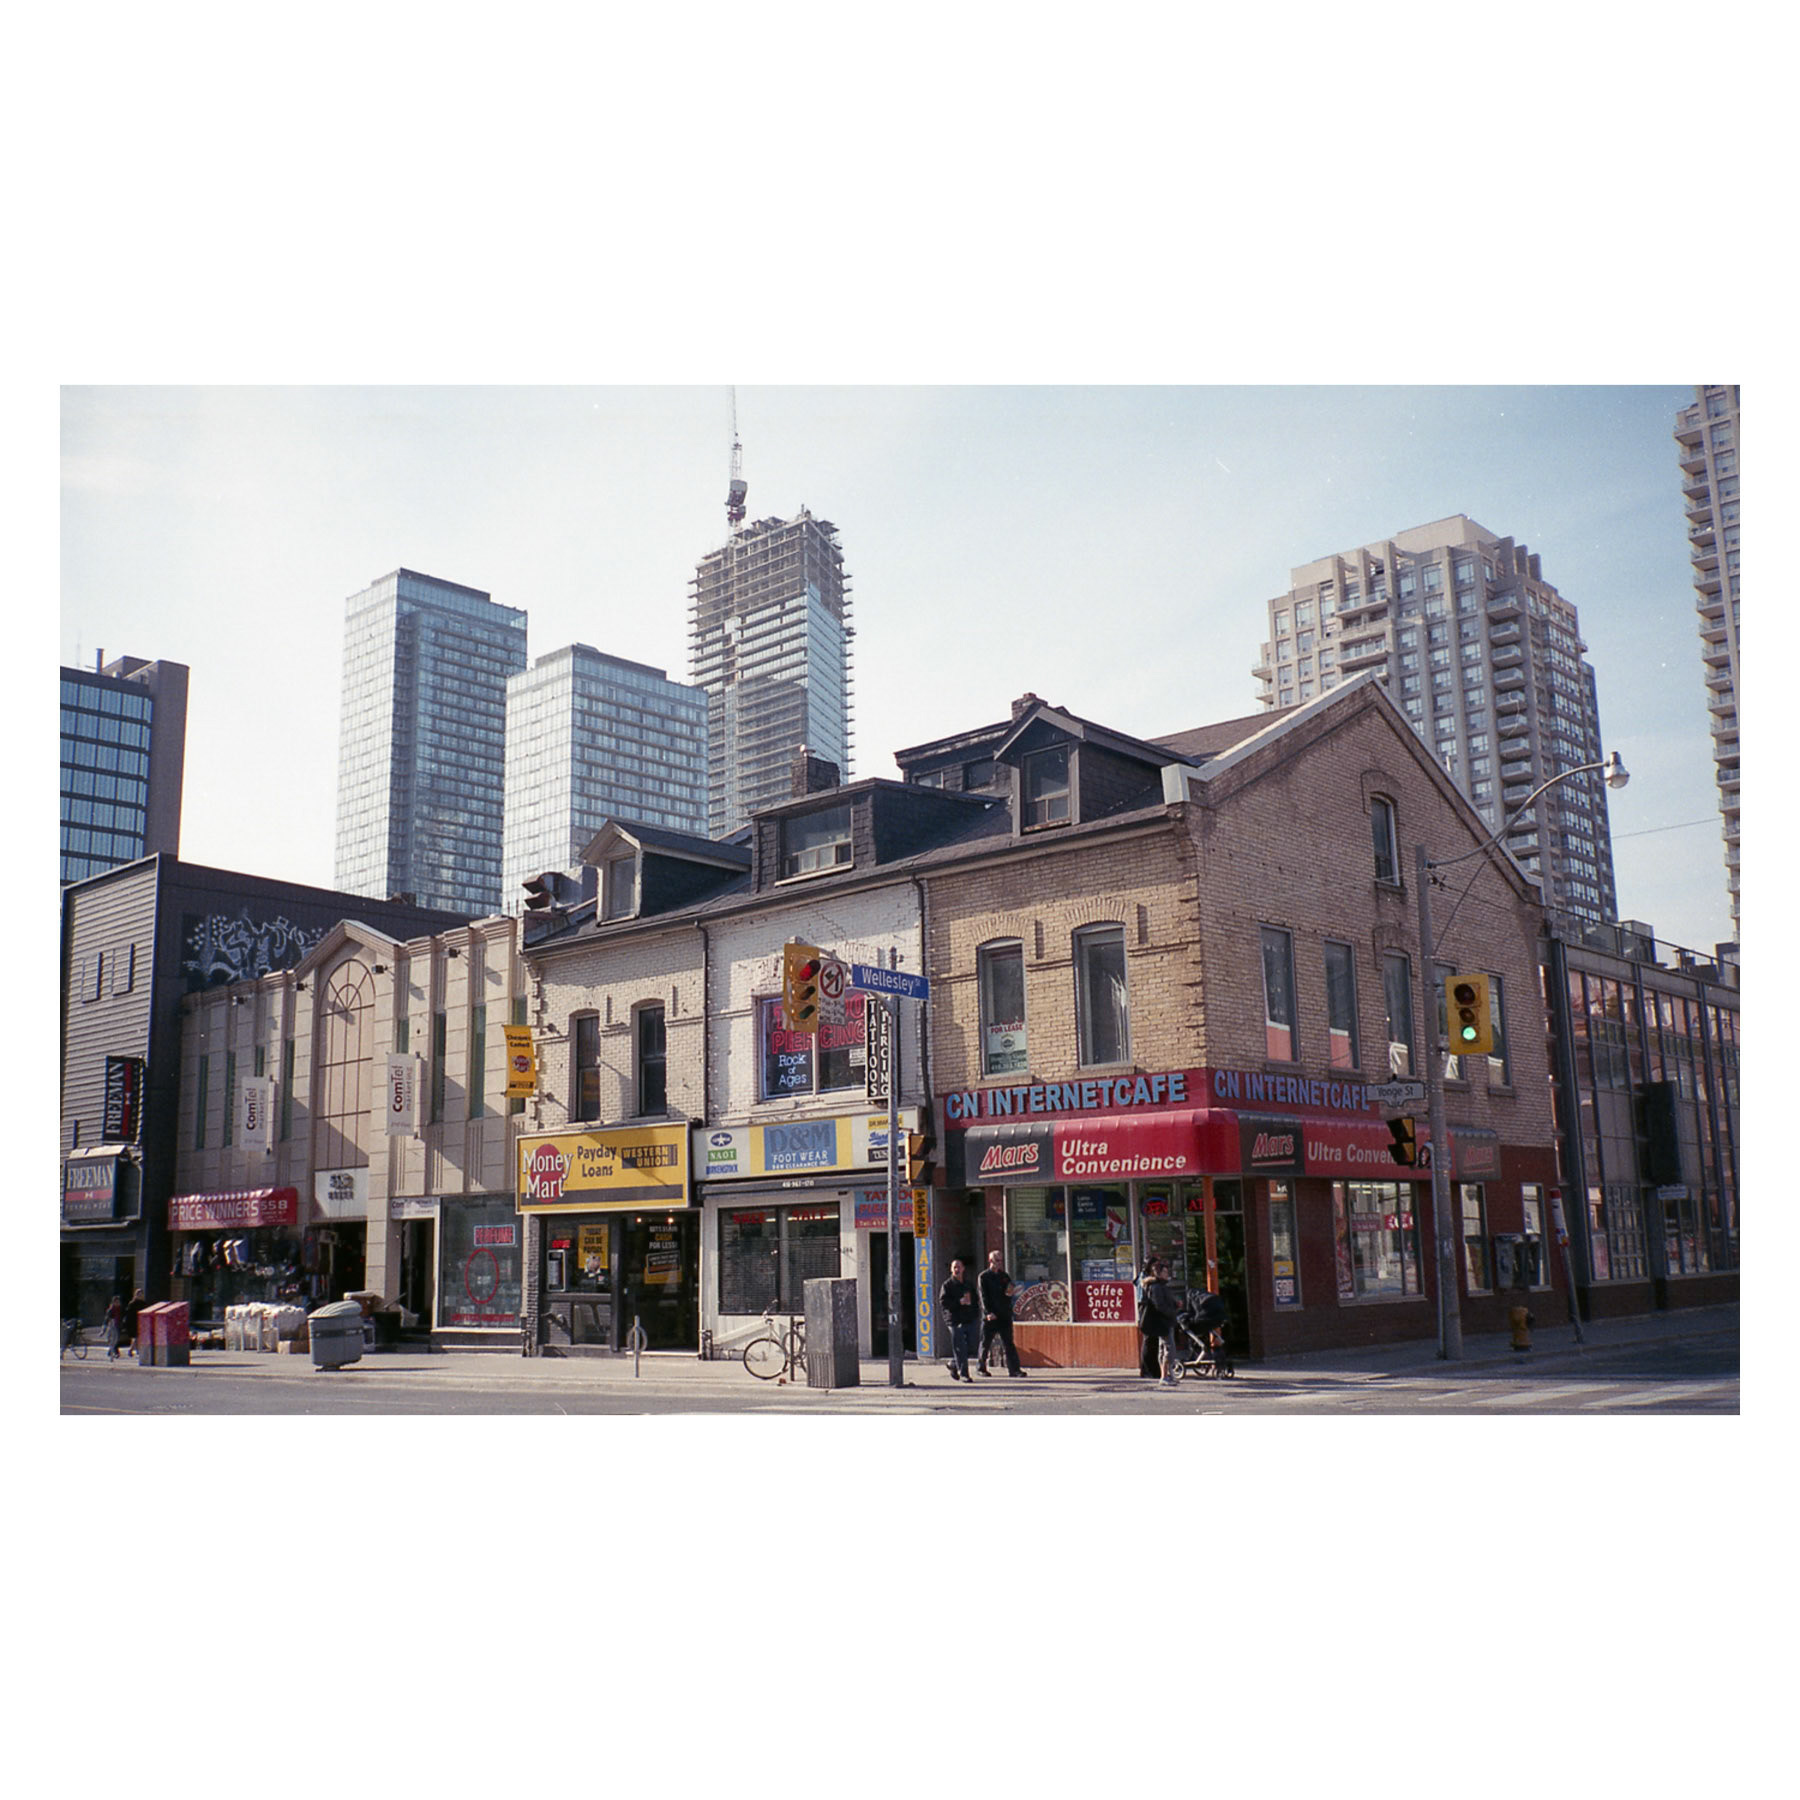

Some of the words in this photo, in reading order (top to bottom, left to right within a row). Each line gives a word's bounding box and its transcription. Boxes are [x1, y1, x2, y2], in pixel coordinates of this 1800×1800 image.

[861, 967, 914, 996] Wellesley
[869, 1001, 878, 1096] TATTOOS
[779, 1054, 807, 1067] Rock
[788, 1066, 796, 1074] of
[390, 1065, 403, 1113] ComTel
[779, 1074, 807, 1087] Ages
[1214, 1070, 1240, 1098] CN
[106, 1062, 125, 1134] FREEMAN
[947, 1091, 981, 1119] CN
[987, 1073, 1187, 1115] INTERNETCAFE
[1377, 1086, 1402, 1098] Yonge
[1405, 1085, 1414, 1096] St
[245, 1088, 257, 1131] ComTel
[768, 1124, 831, 1153] D&M
[1061, 1139, 1108, 1158] Ultra
[1252, 1132, 1295, 1159] Mars
[577, 1144, 617, 1161] Payday
[623, 1147, 669, 1159] WESTERN
[636, 1156, 669, 1168] UNION
[773, 1152, 797, 1163] FOOT
[800, 1150, 828, 1161] WEAR
[979, 1142, 1040, 1171] Mars
[1308, 1142, 1342, 1163] Ultra
[522, 1149, 573, 1180] Money
[582, 1164, 613, 1177] Loans
[1061, 1153, 1187, 1175] Convenience
[67, 1164, 113, 1190] FREEMAN
[526, 1173, 564, 1199] Mart
[172, 1204, 202, 1220] PRICE
[204, 1200, 259, 1219] WINNERS
[261, 1200, 288, 1210] 558
[1086, 1284, 1124, 1296] Coffee
[1088, 1299, 1122, 1308] Snack
[1092, 1309, 1120, 1320] Cake
